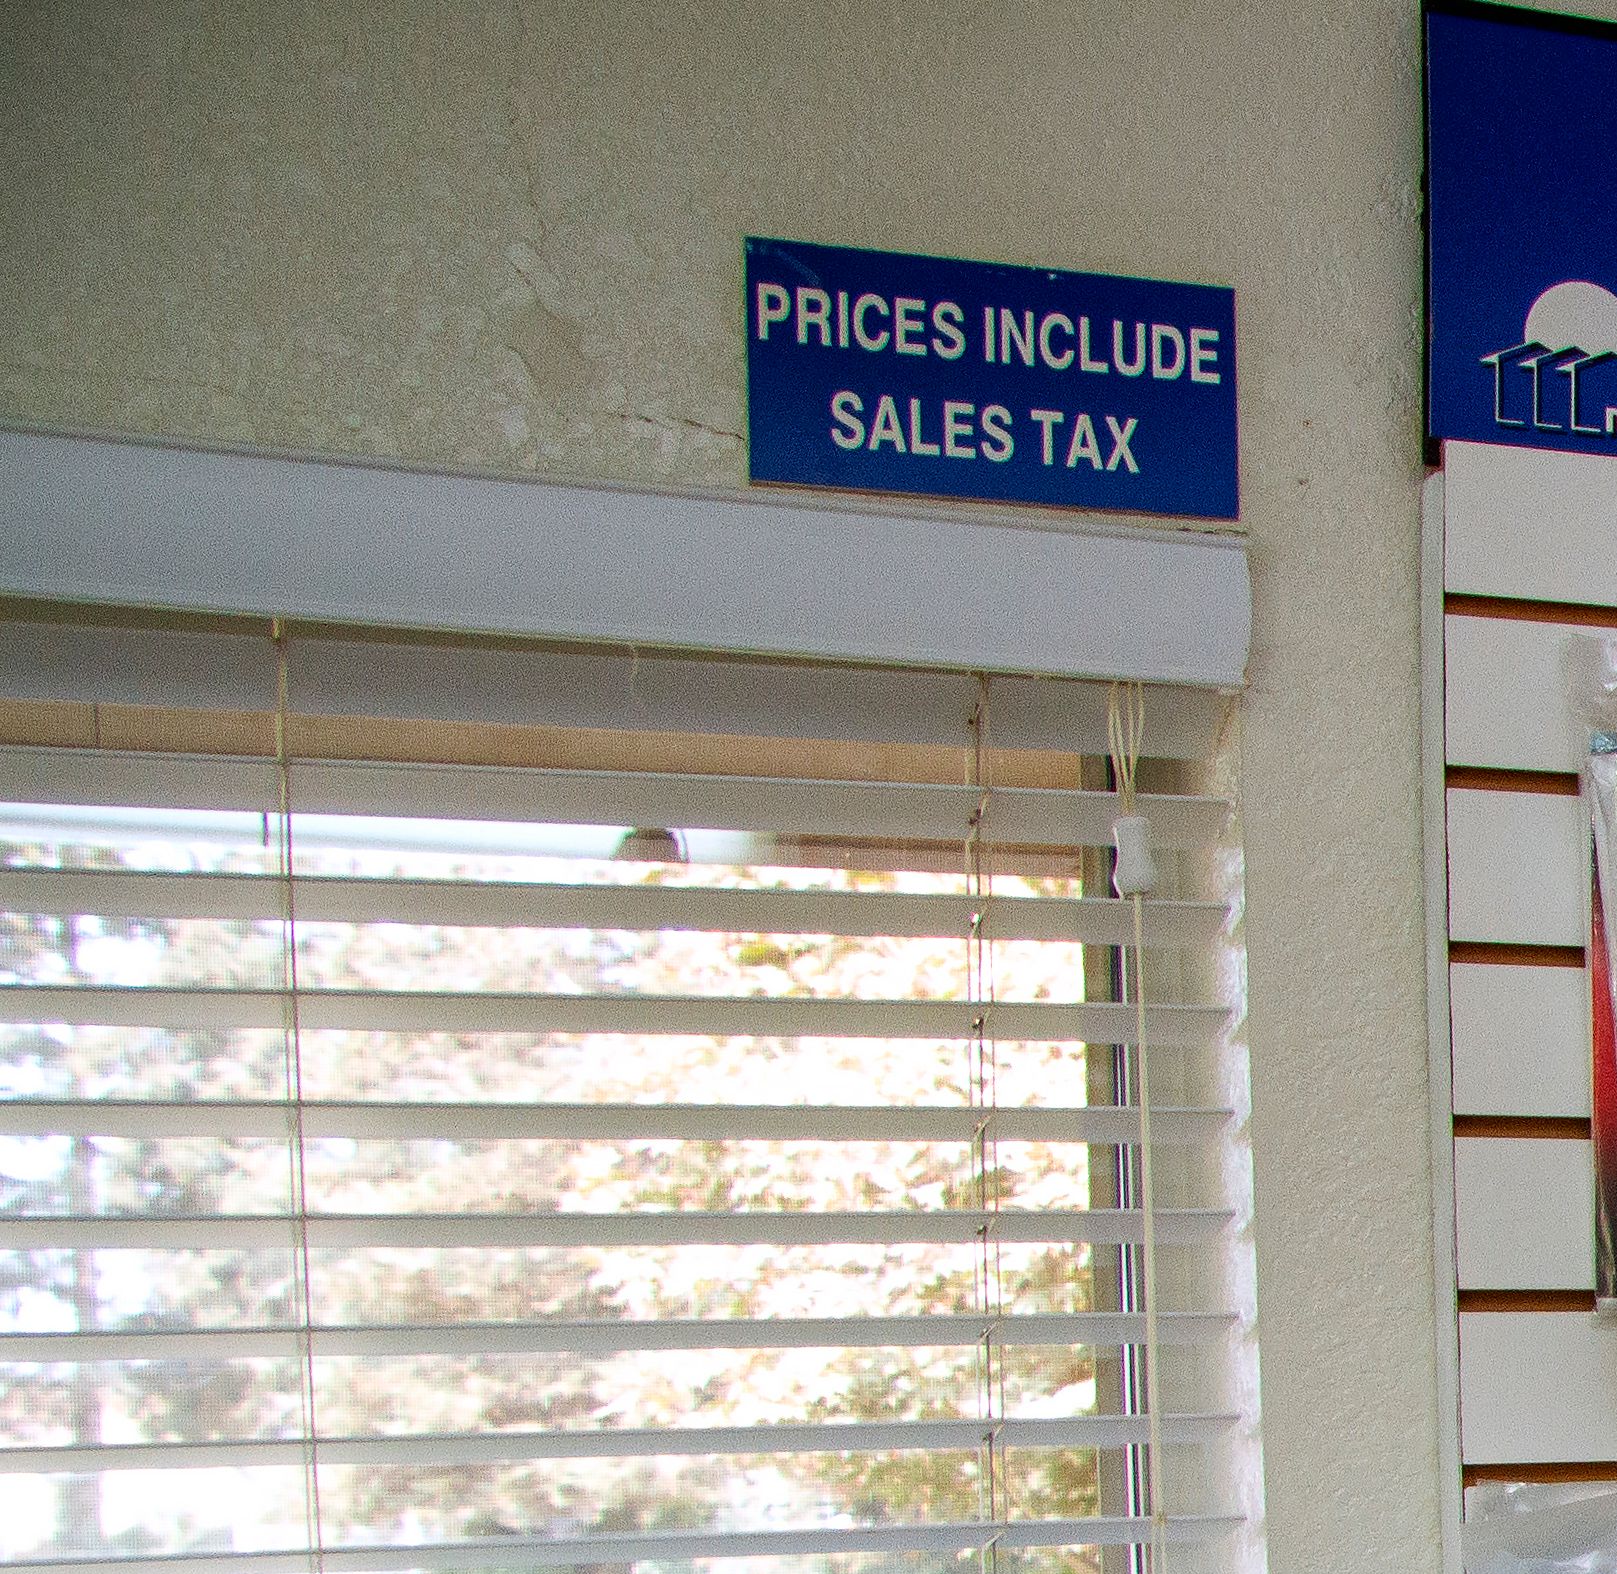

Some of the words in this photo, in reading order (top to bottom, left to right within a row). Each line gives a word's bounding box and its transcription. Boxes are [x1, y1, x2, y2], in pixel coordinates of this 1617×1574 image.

[757, 283, 966, 360] PRICES
[984, 307, 1221, 384] INCLUDE
[831, 391, 1014, 462] SALES
[1031, 408, 1139, 474] TAX
